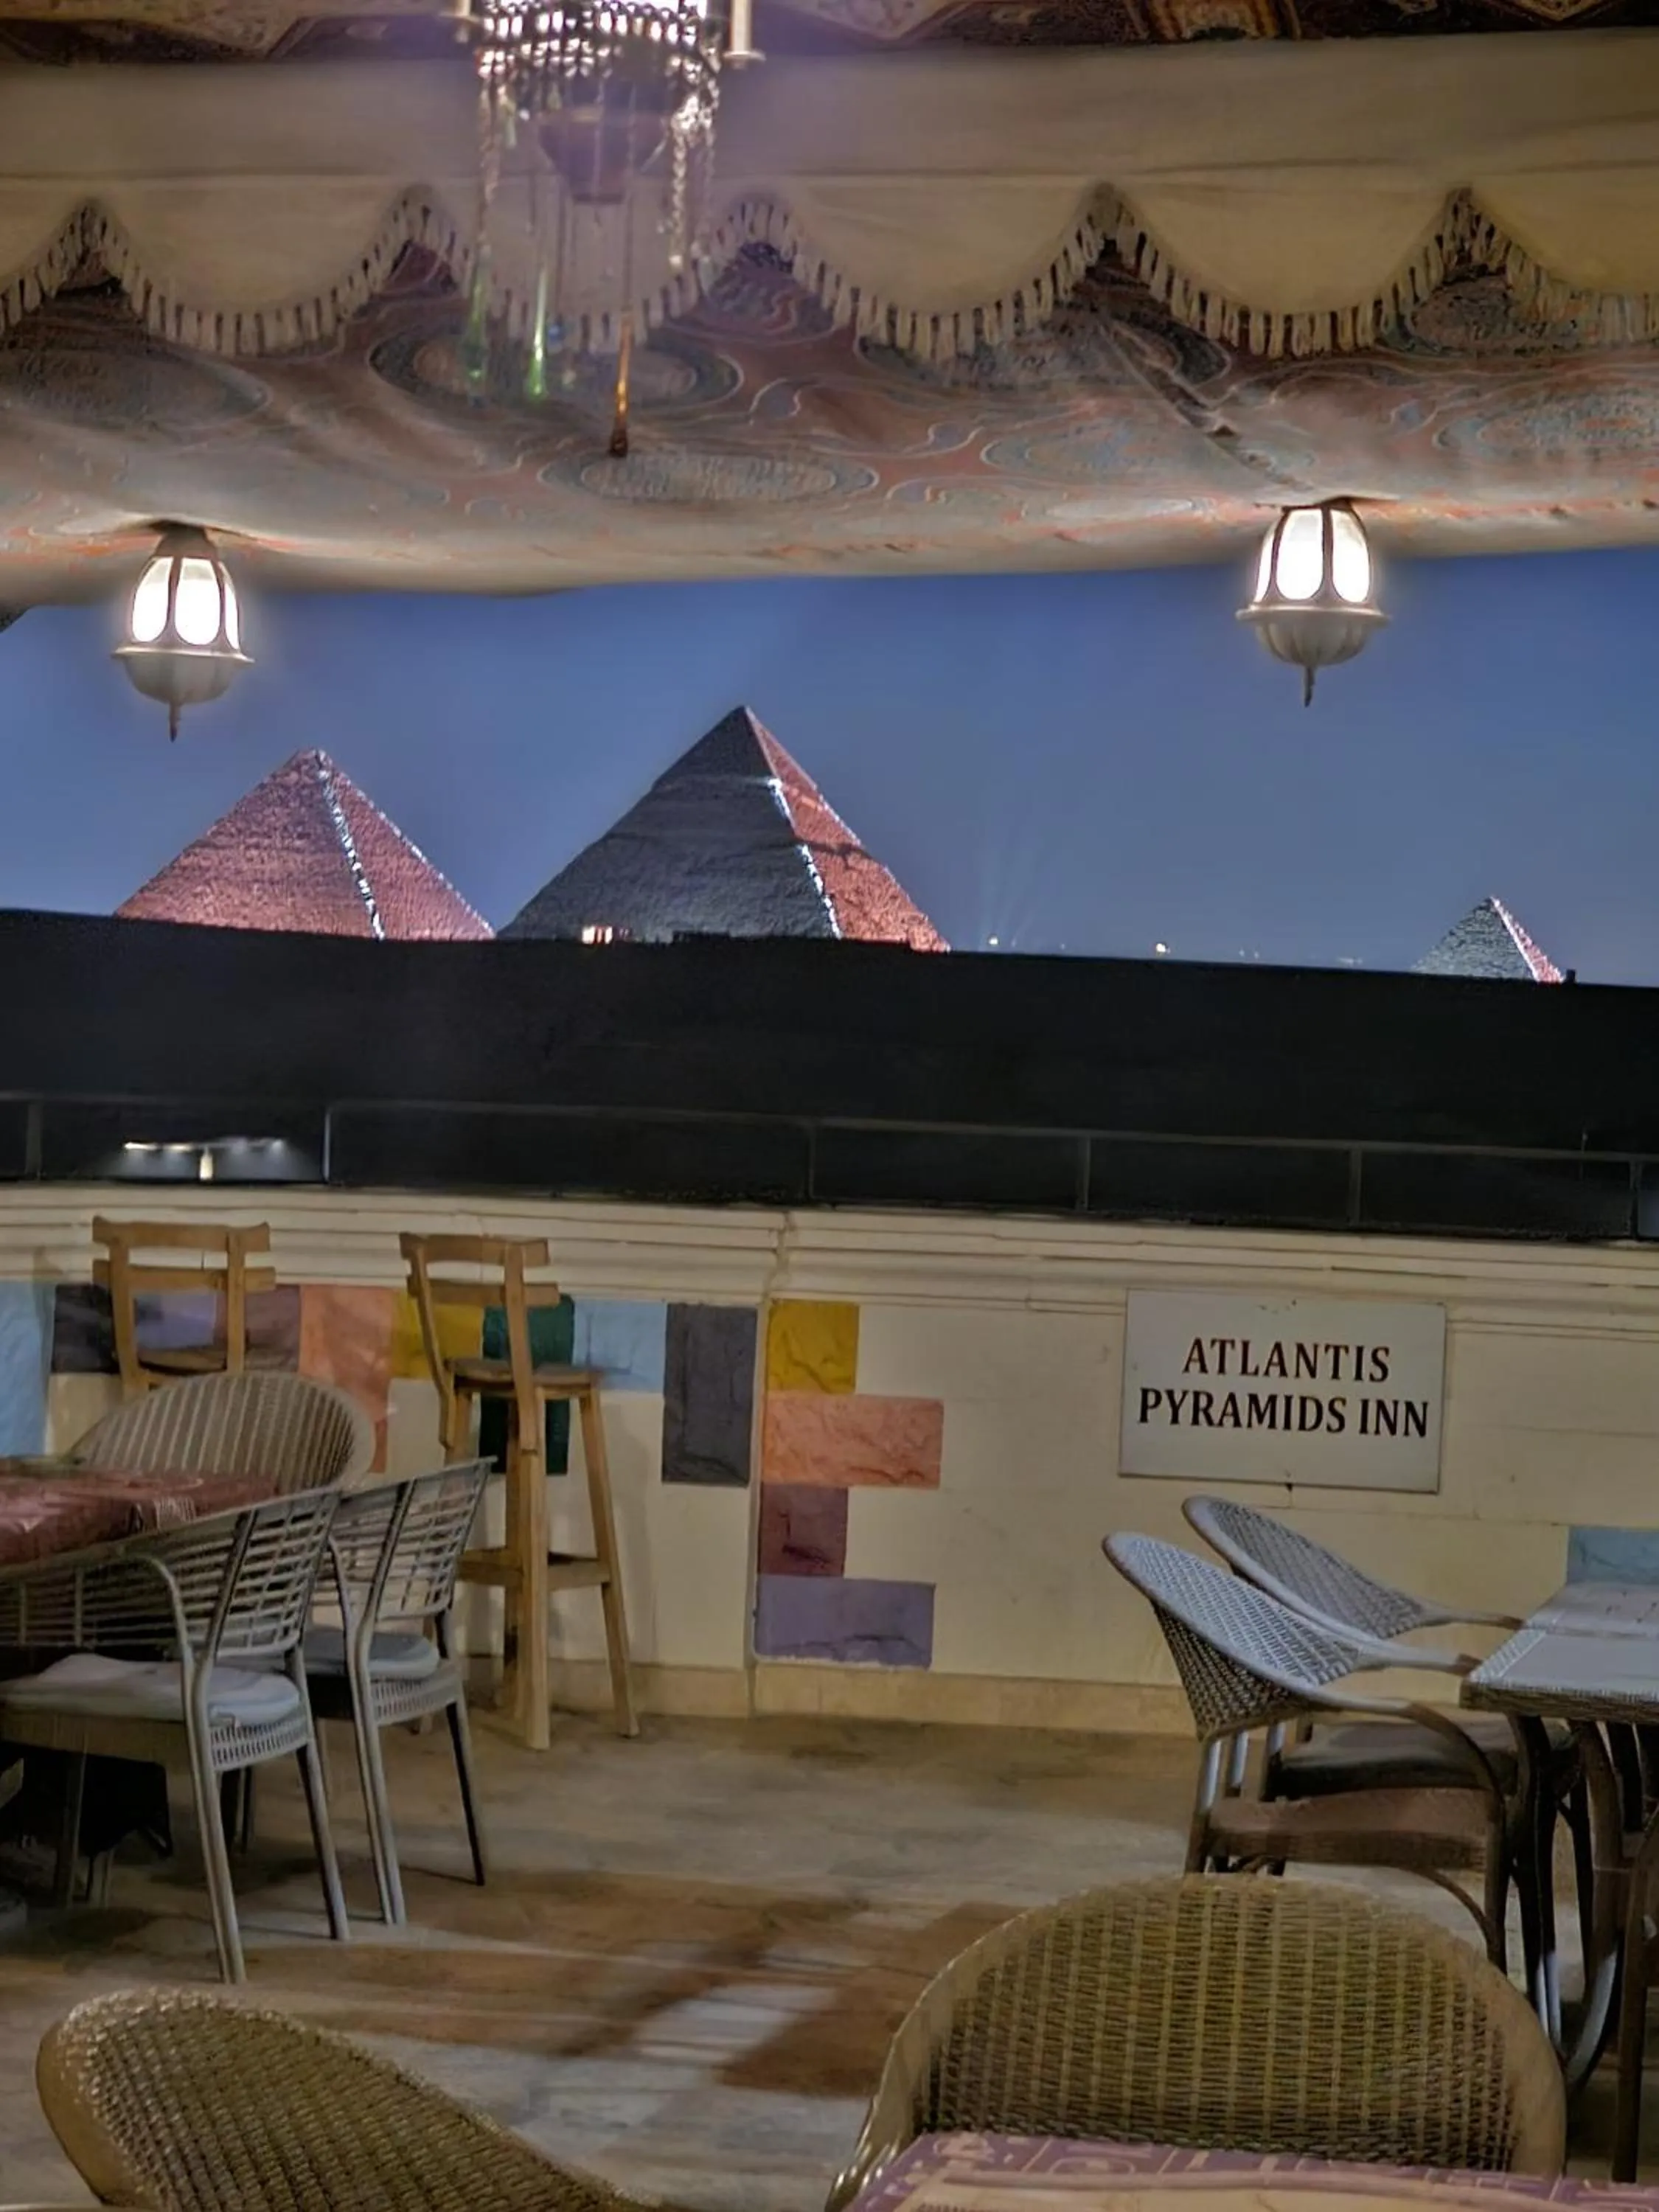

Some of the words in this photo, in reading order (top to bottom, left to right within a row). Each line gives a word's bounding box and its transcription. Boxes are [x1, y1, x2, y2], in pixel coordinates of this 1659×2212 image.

[1183, 1337, 1390, 1382] ATLANTIS
[1138, 1387, 1346, 1433] PYRAMIDS
[1359, 1398, 1428, 1438] INN
